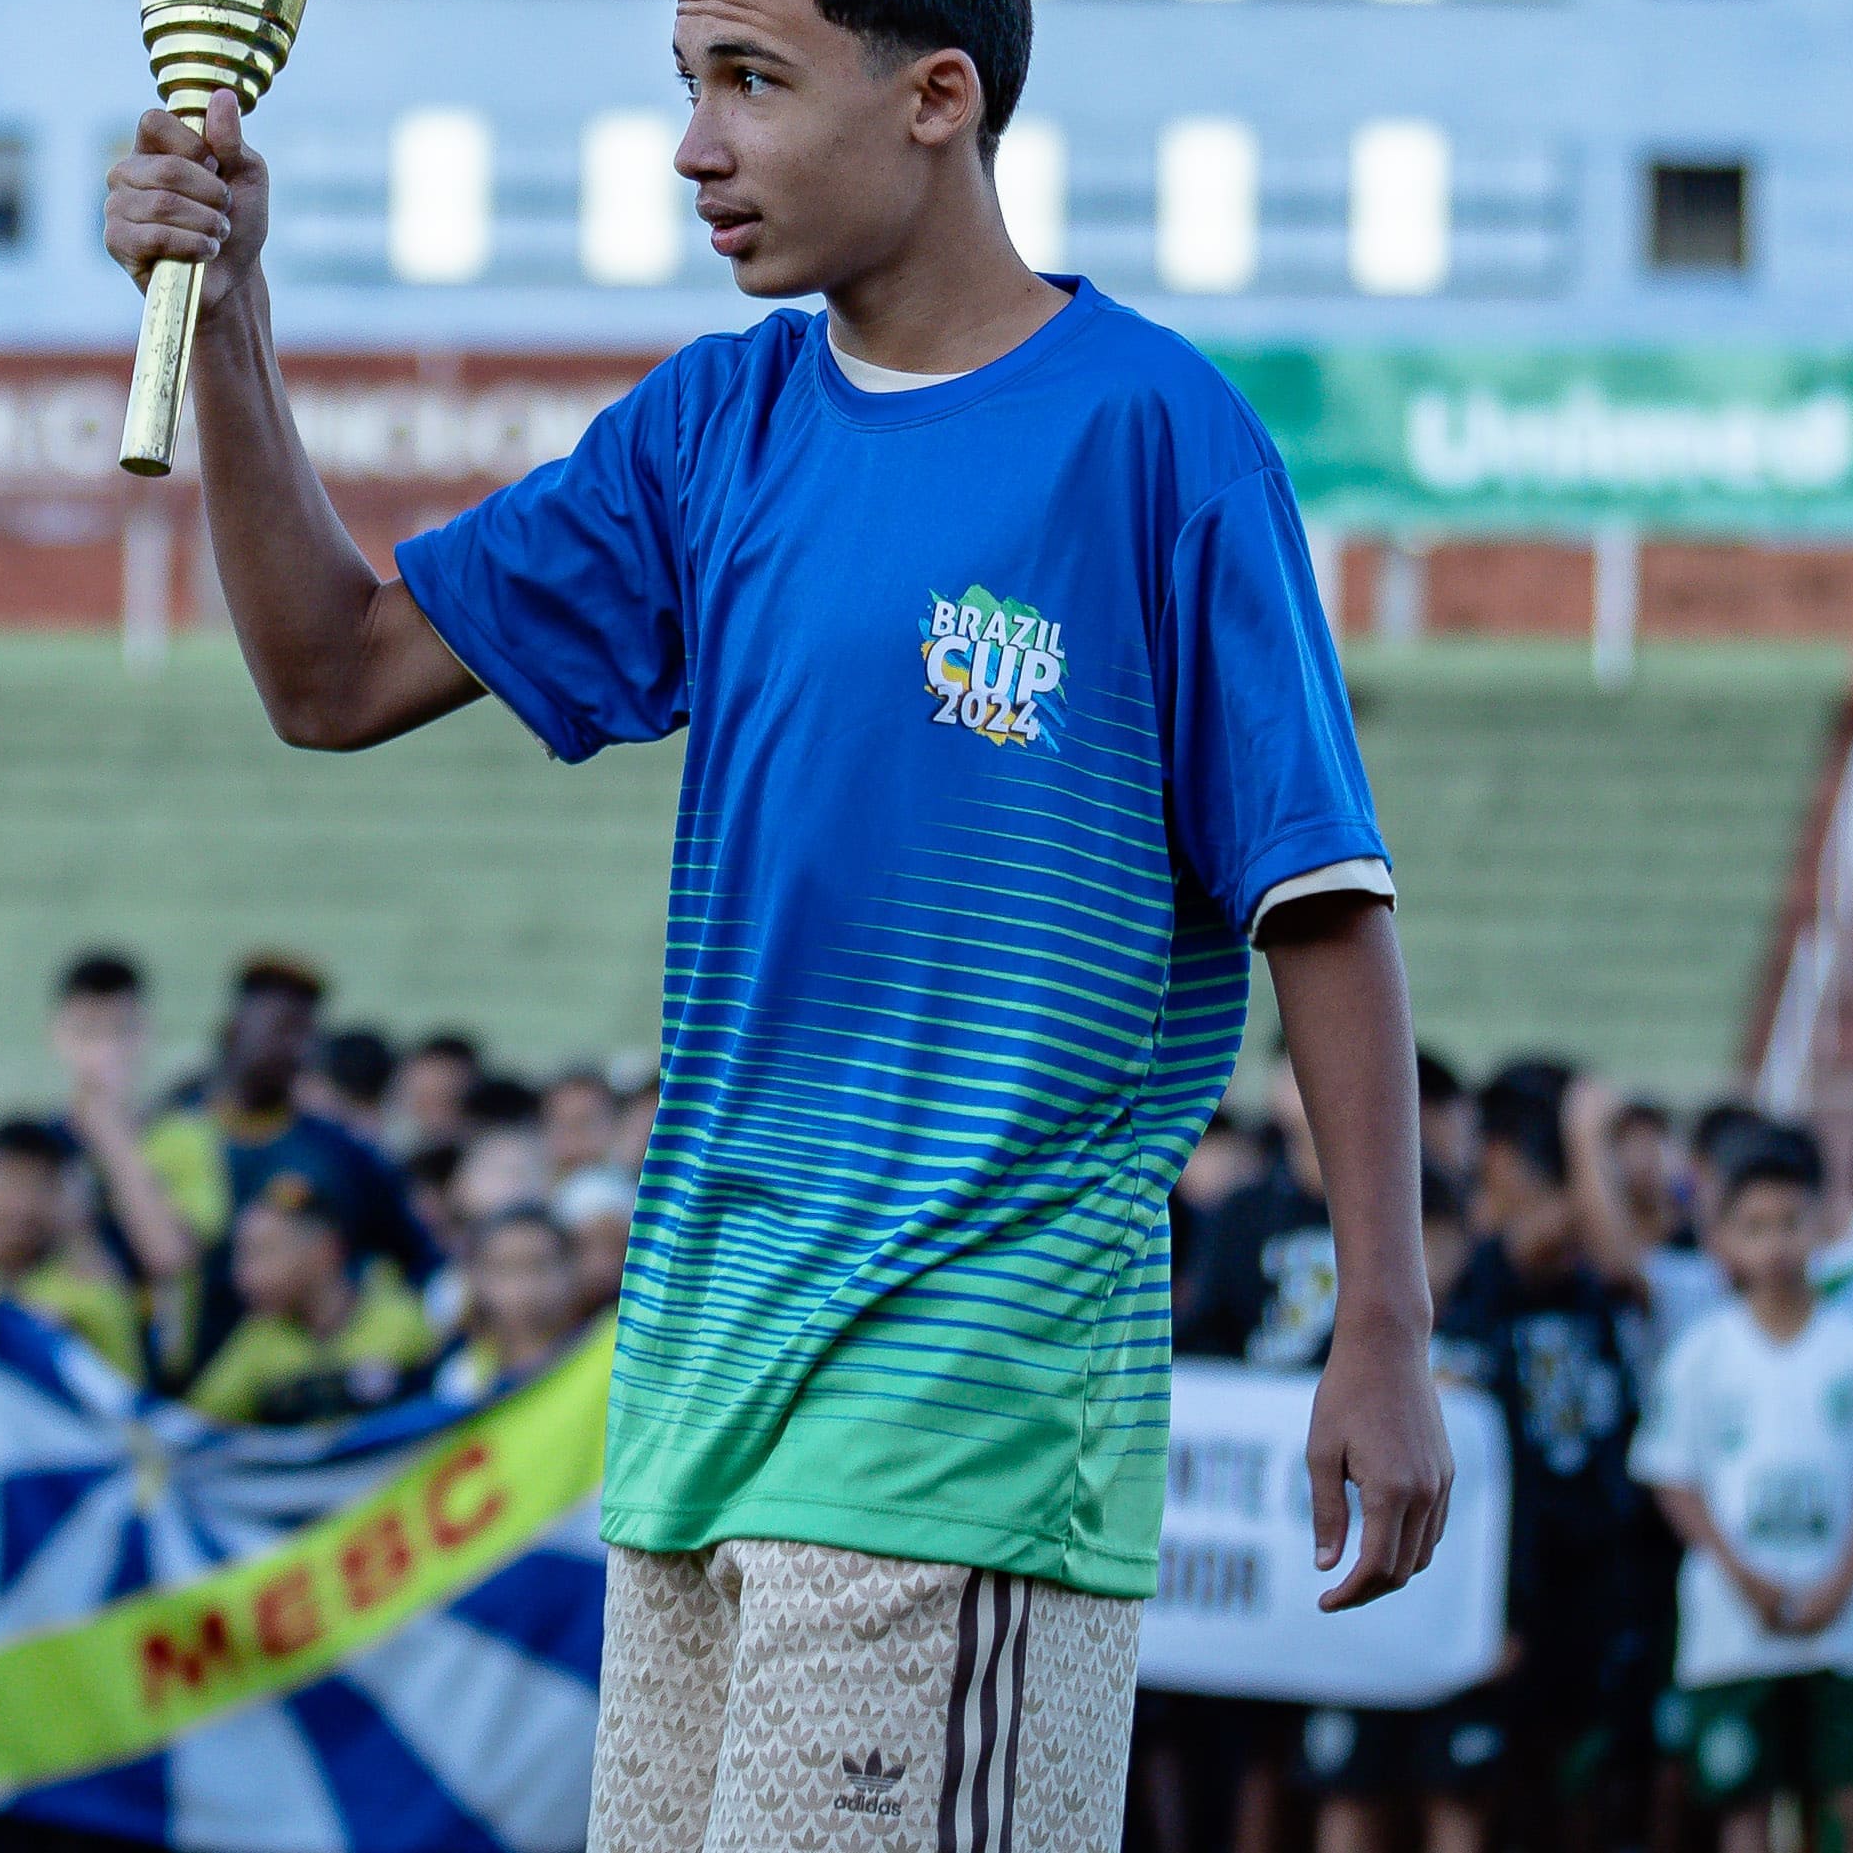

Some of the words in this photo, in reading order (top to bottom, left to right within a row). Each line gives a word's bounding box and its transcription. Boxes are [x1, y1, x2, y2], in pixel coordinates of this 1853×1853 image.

[932, 600, 1065, 659] BRAZIL
[927, 635, 1060, 702] CUP
[933, 685, 1040, 741] 2024
[834, 1792, 901, 1817] adidas
